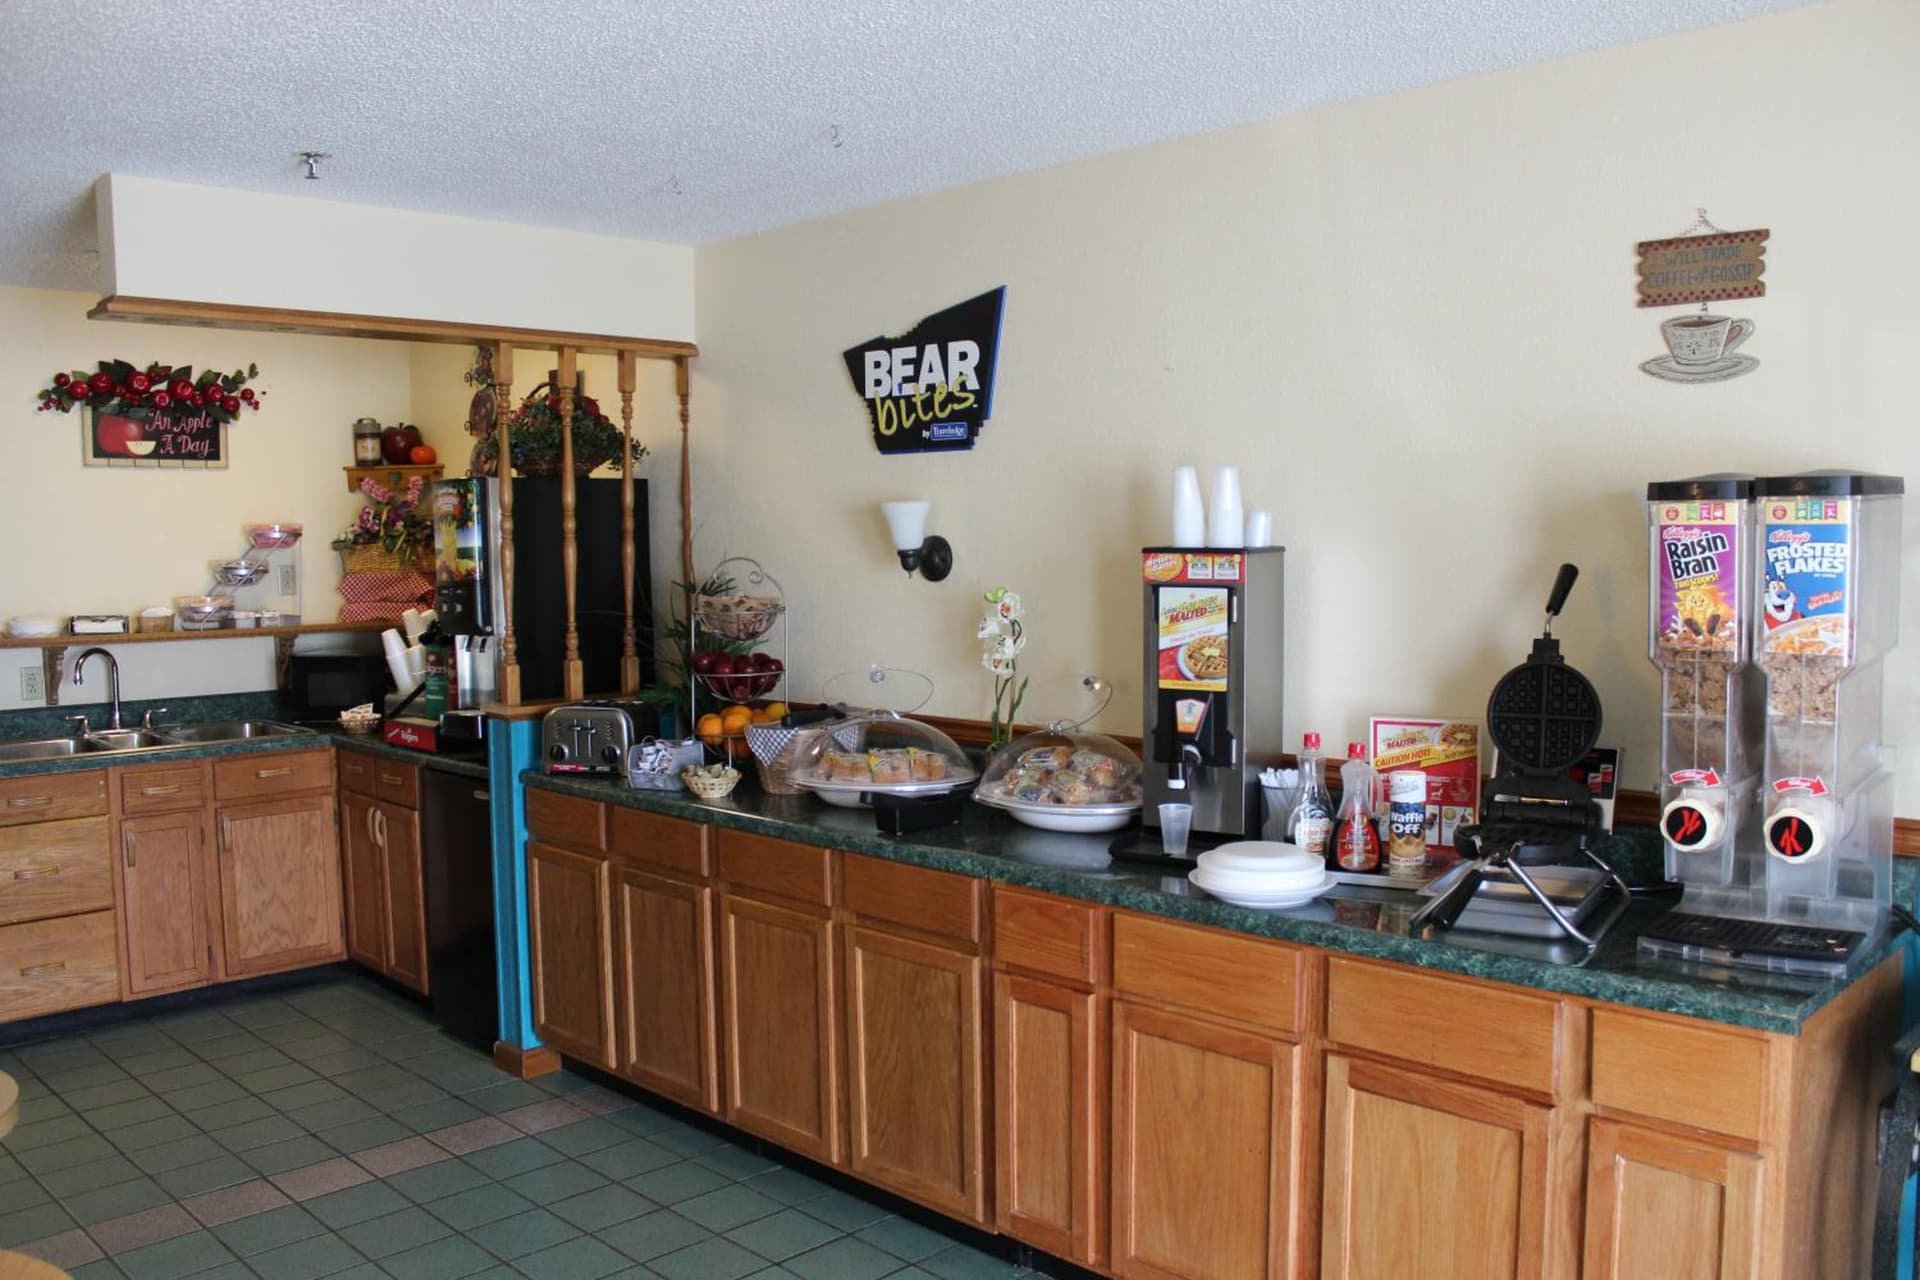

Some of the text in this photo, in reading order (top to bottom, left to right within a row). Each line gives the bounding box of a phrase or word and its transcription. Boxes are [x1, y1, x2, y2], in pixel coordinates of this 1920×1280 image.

[1710, 263, 1756, 283] GOSSIP
[864, 339, 980, 399] BEAR
[874, 374, 975, 435] bites
[145, 409, 214, 434] An Apple
[160, 434, 212, 458] A Day
[1665, 532, 1728, 560] Raisin
[1766, 542, 1847, 562] FROSTED
[1670, 555, 1718, 579] Bran
[1774, 558, 1845, 576] FLAKES
[1375, 752, 1410, 767] CAUTION
